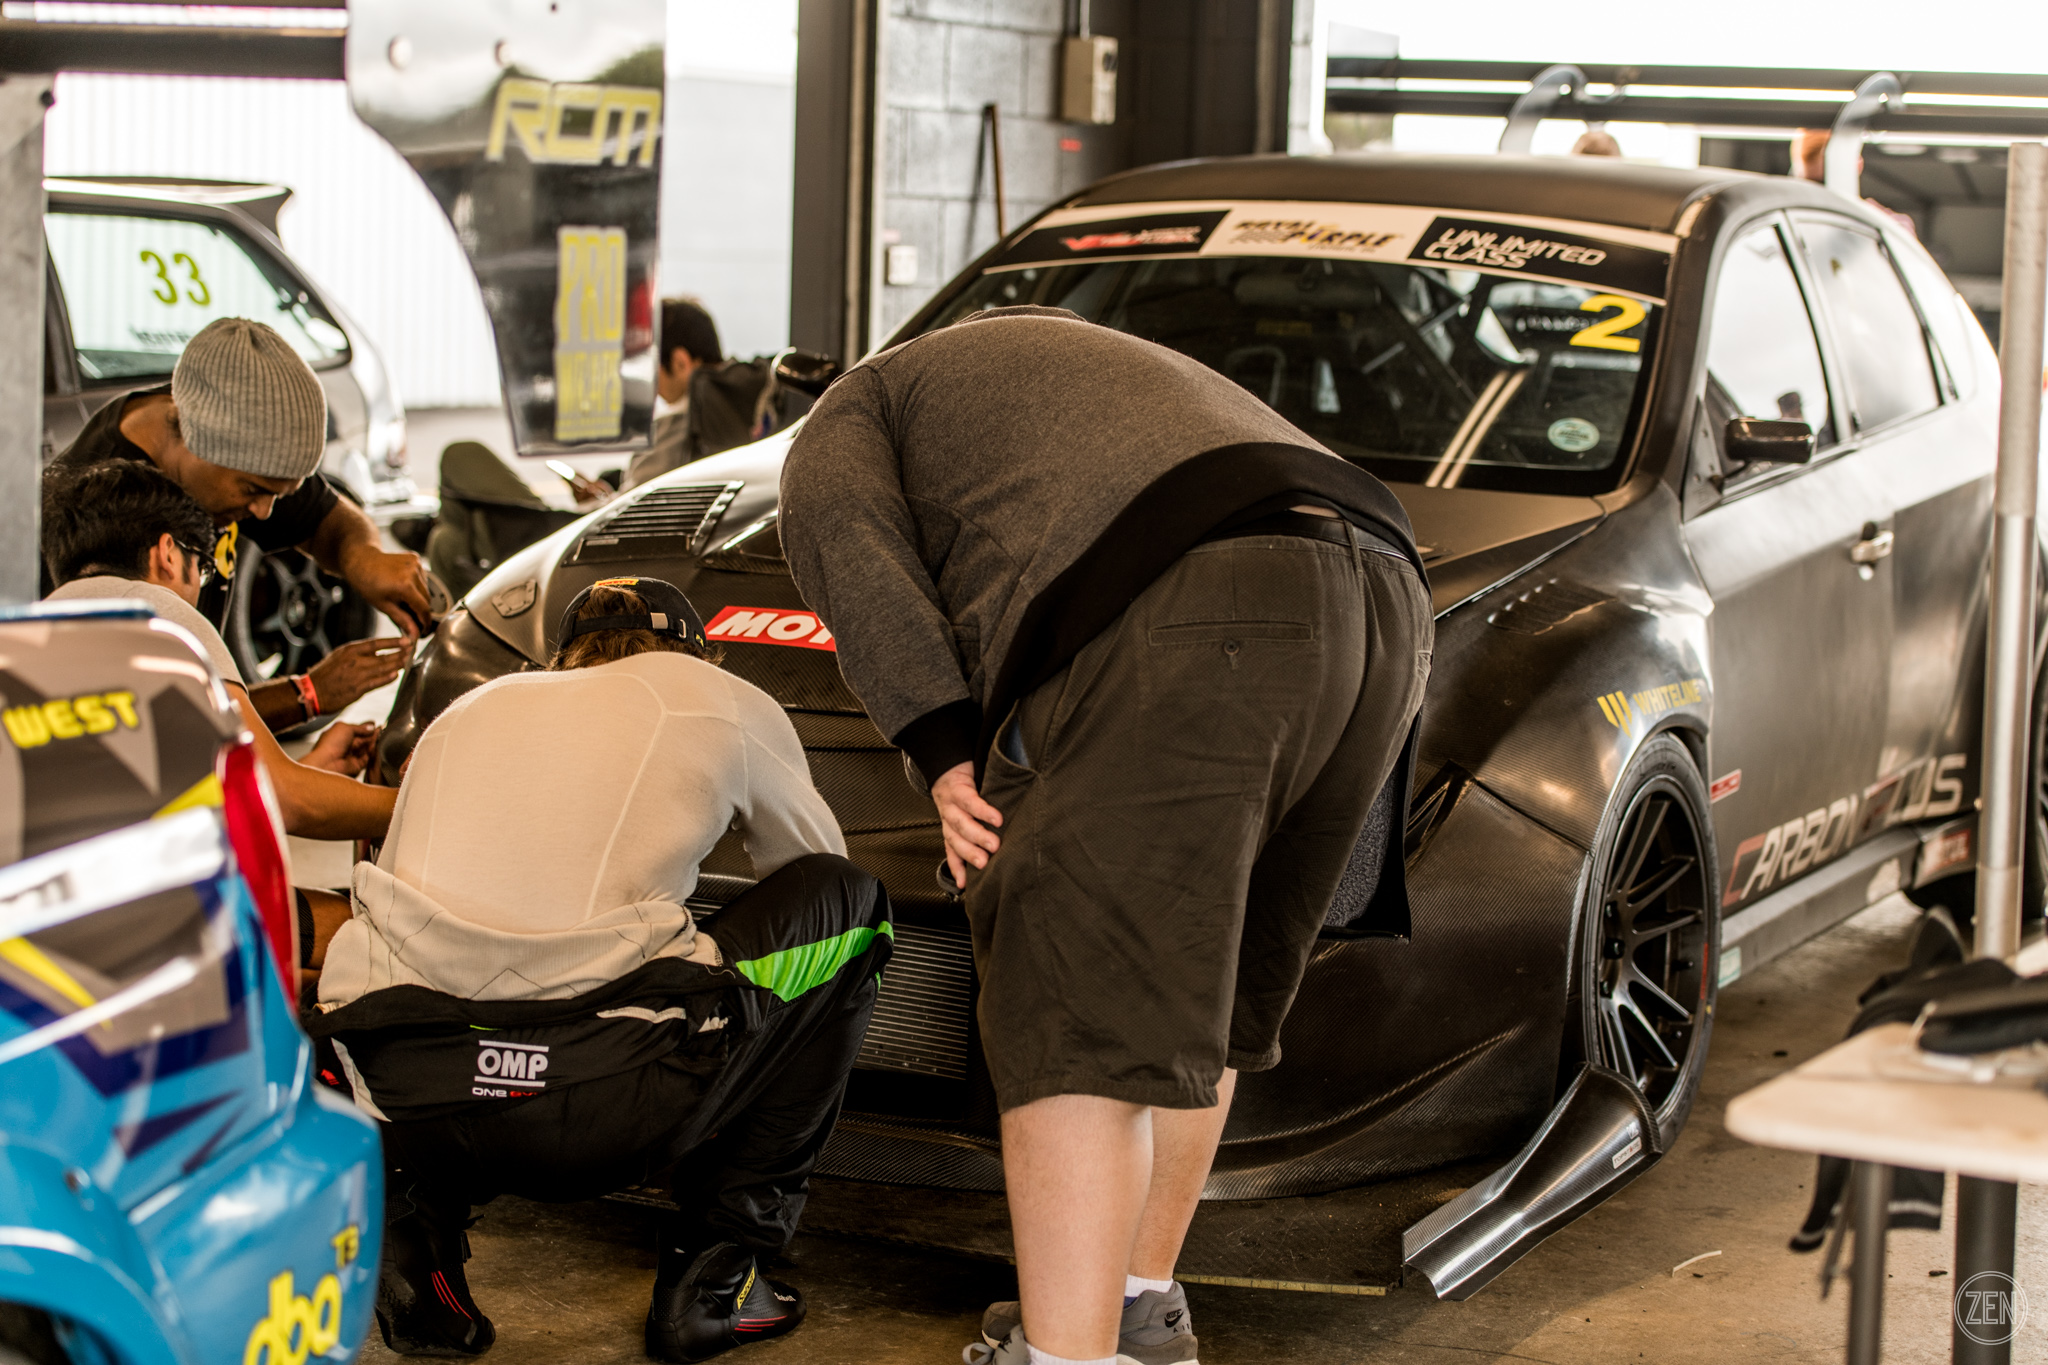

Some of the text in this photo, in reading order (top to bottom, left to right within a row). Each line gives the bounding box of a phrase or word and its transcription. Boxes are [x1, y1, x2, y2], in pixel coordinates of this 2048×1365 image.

[1423, 240, 1531, 269] CLASS
[1438, 227, 1607, 267] UNLIMITED
[140, 250, 210, 306] 33
[1569, 293, 1647, 353] 2
[2, 691, 139, 749] WEST
[477, 1047, 549, 1081] OMP
